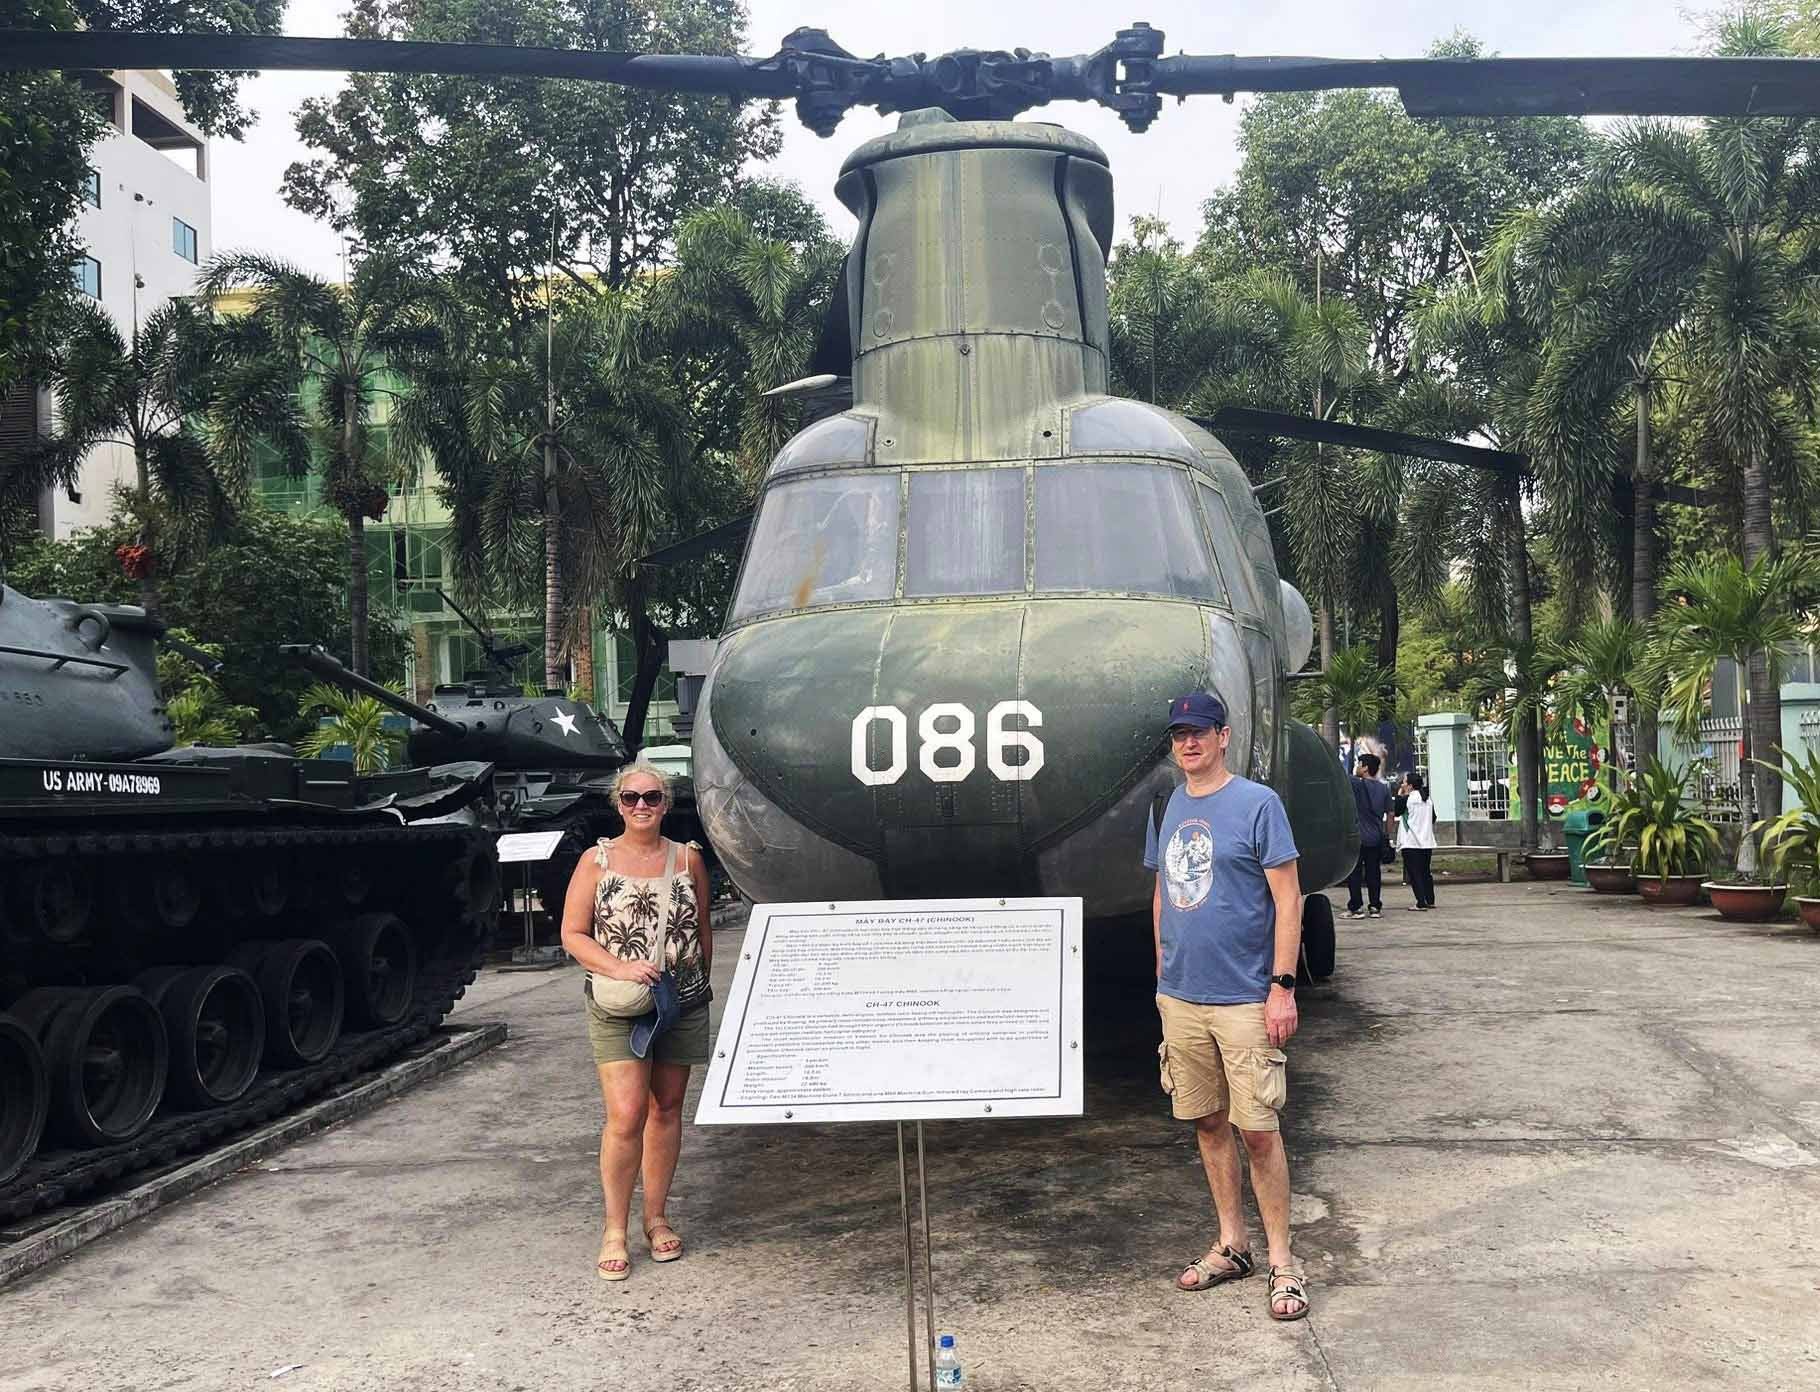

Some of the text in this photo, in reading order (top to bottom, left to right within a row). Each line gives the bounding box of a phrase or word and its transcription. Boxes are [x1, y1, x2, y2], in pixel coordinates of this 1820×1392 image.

[851, 700, 1045, 786] 086
[1566, 744, 1587, 759] The
[43, 770, 160, 794] US ARMY-09A78969
[1545, 761, 1590, 783] EACE
[926, 915, 976, 924] (CHINOOK)
